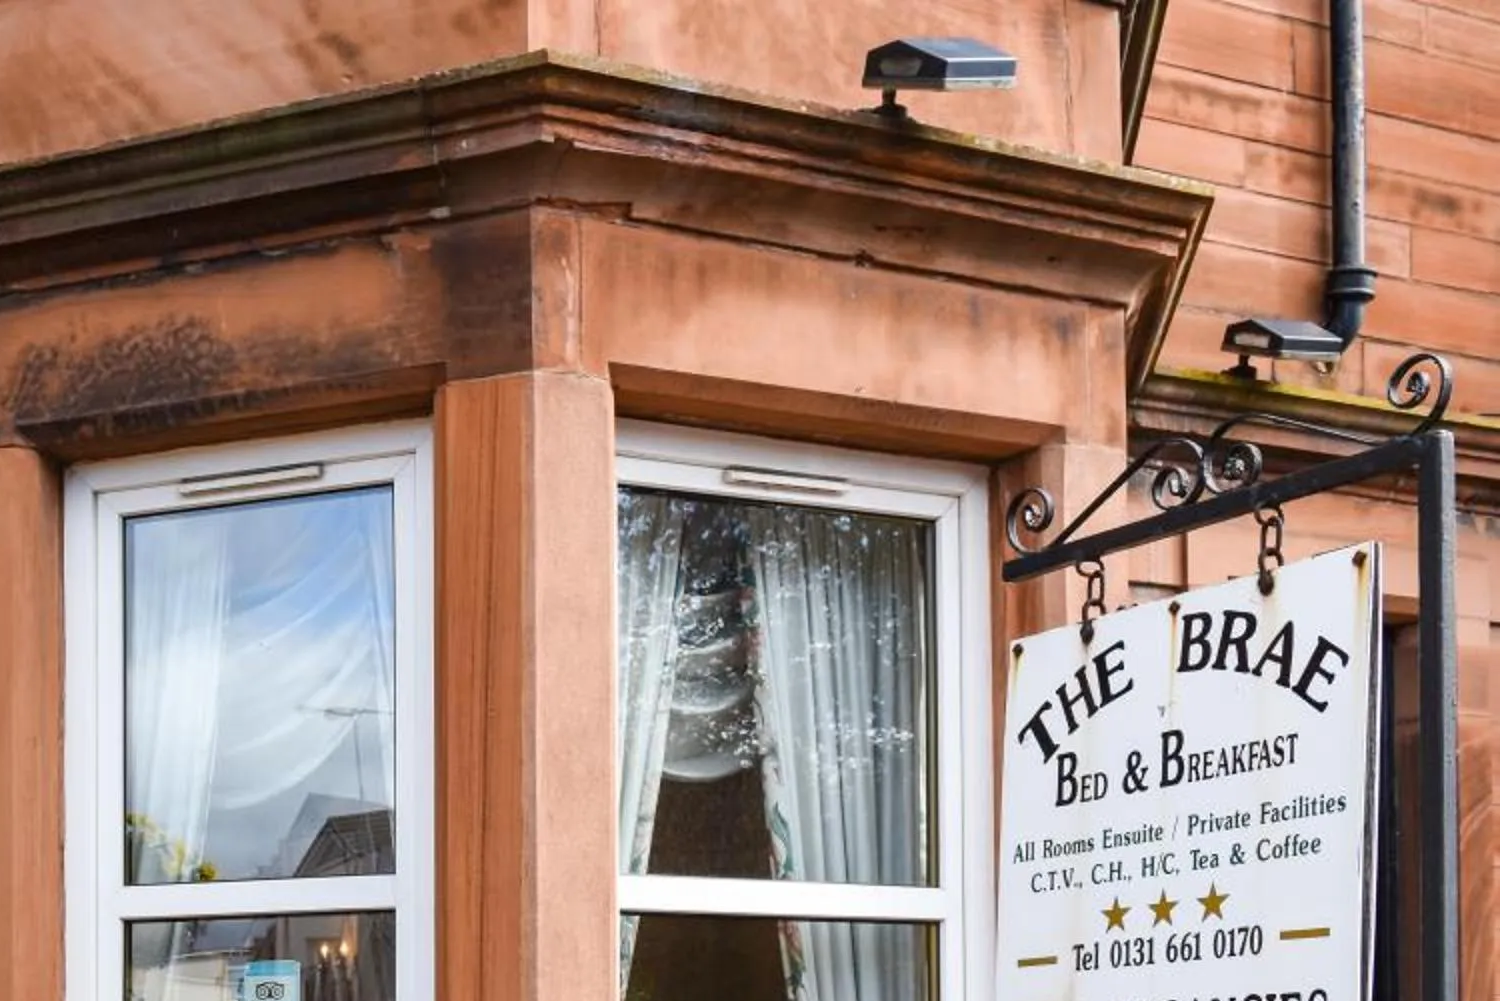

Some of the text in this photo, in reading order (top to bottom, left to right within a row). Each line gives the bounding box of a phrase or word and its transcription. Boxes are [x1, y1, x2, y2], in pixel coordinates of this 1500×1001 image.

[1017, 609, 1350, 764] THE BRAE
[1122, 750, 1149, 795] &
[1013, 841, 1035, 864] All
[1043, 837, 1095, 858] Rooms
[1103, 824, 1165, 849] Ensuite
[1188, 808, 1252, 836] Private
[1260, 793, 1348, 825] Facilities
[1190, 847, 1220, 869] Tea
[1230, 843, 1247, 865] &
[1256, 833, 1323, 861] Coffee
[1073, 925, 1264, 971] Tel 0131 661 0170
